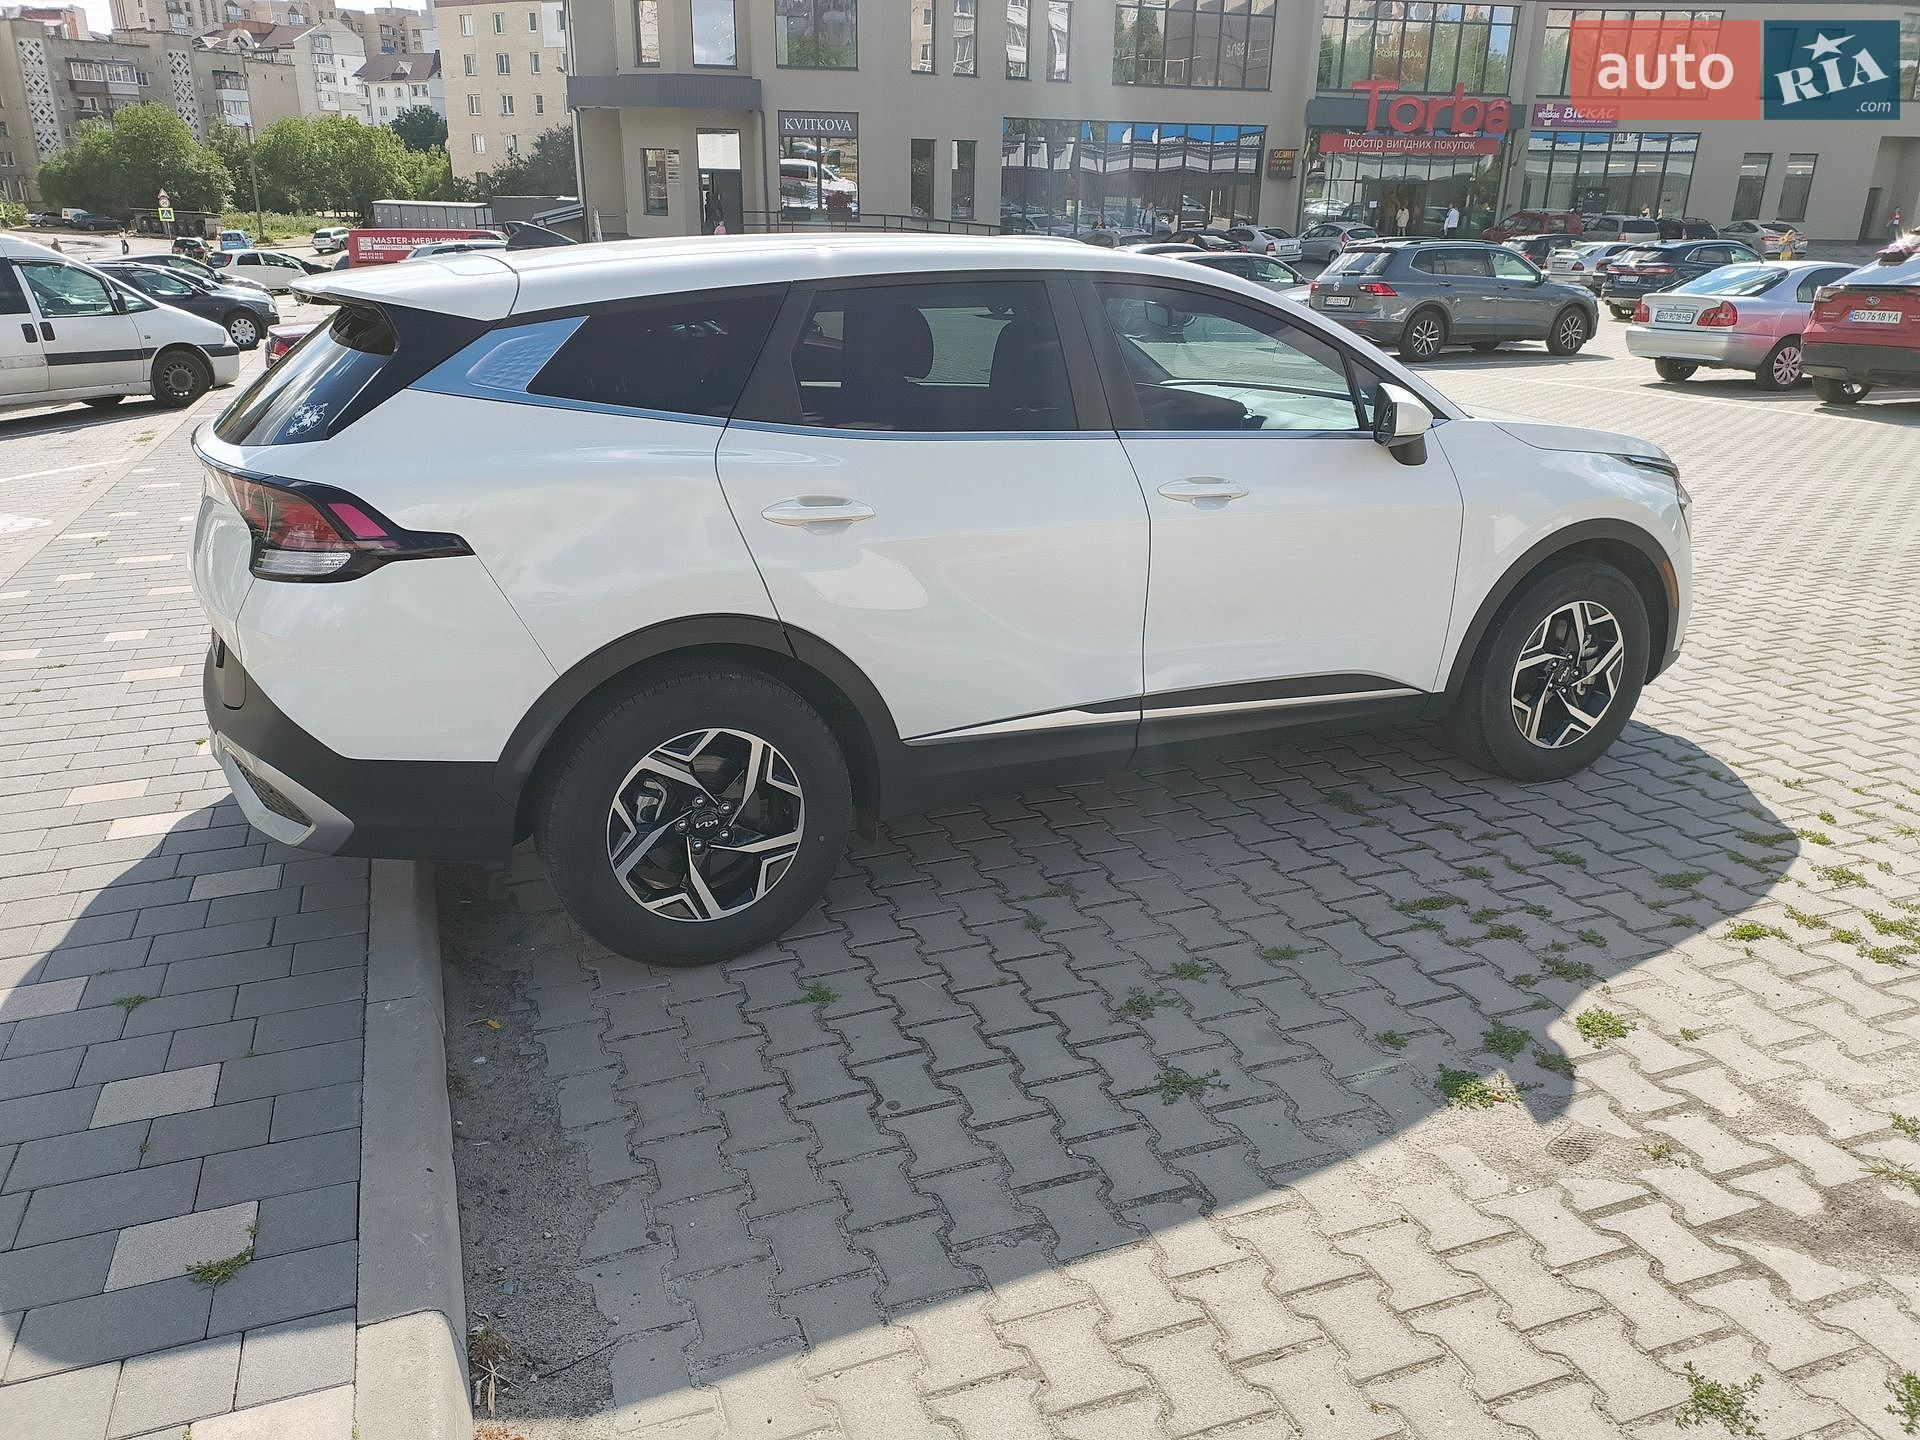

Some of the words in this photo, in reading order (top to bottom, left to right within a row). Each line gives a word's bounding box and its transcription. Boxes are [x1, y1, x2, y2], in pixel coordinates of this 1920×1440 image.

[1352, 80, 1511, 133] Torba
[784, 118, 852, 131] KVITKOVA
[1343, 137, 1384, 150] простір
[1386, 138, 1432, 150] вигідних
[1434, 140, 1476, 153] покупок
[1854, 312, 1866, 320] BO
